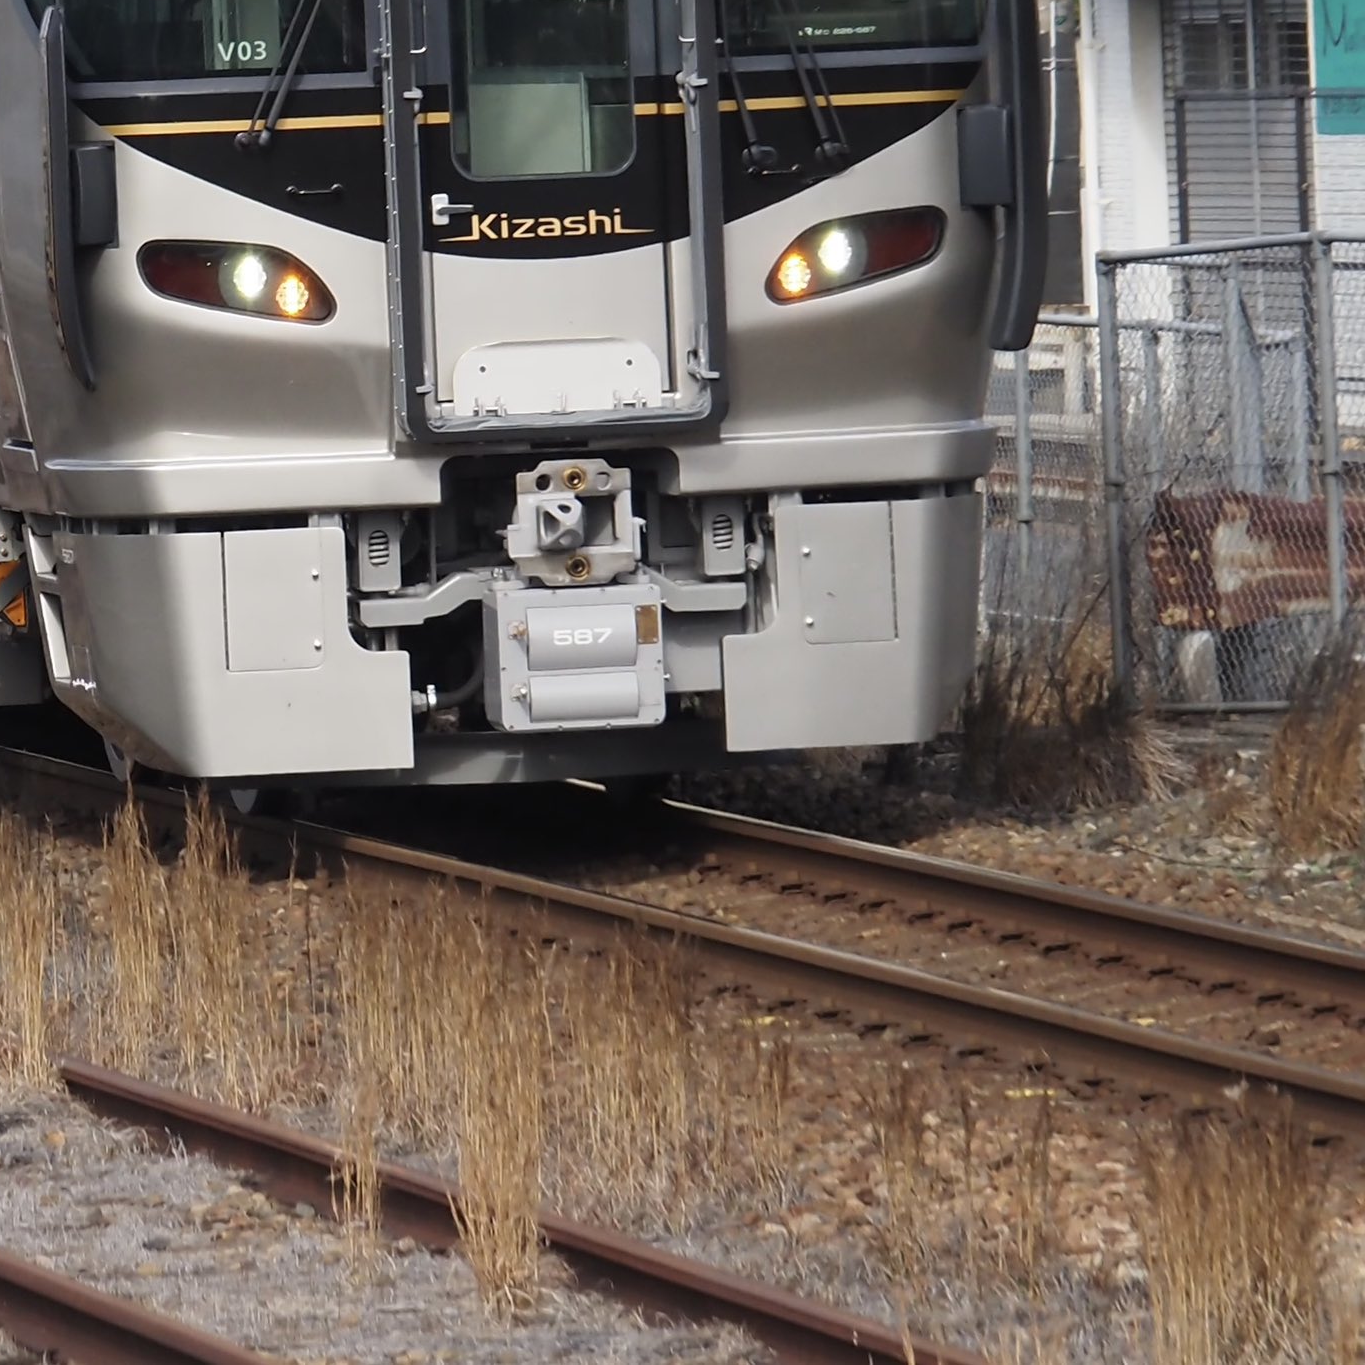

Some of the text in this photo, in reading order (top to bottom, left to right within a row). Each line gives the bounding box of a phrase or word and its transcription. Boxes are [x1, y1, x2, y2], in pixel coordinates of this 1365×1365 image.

[217, 40, 267, 62] V03
[438, 208, 655, 242] Kizashi
[553, 628, 613, 645] 587
